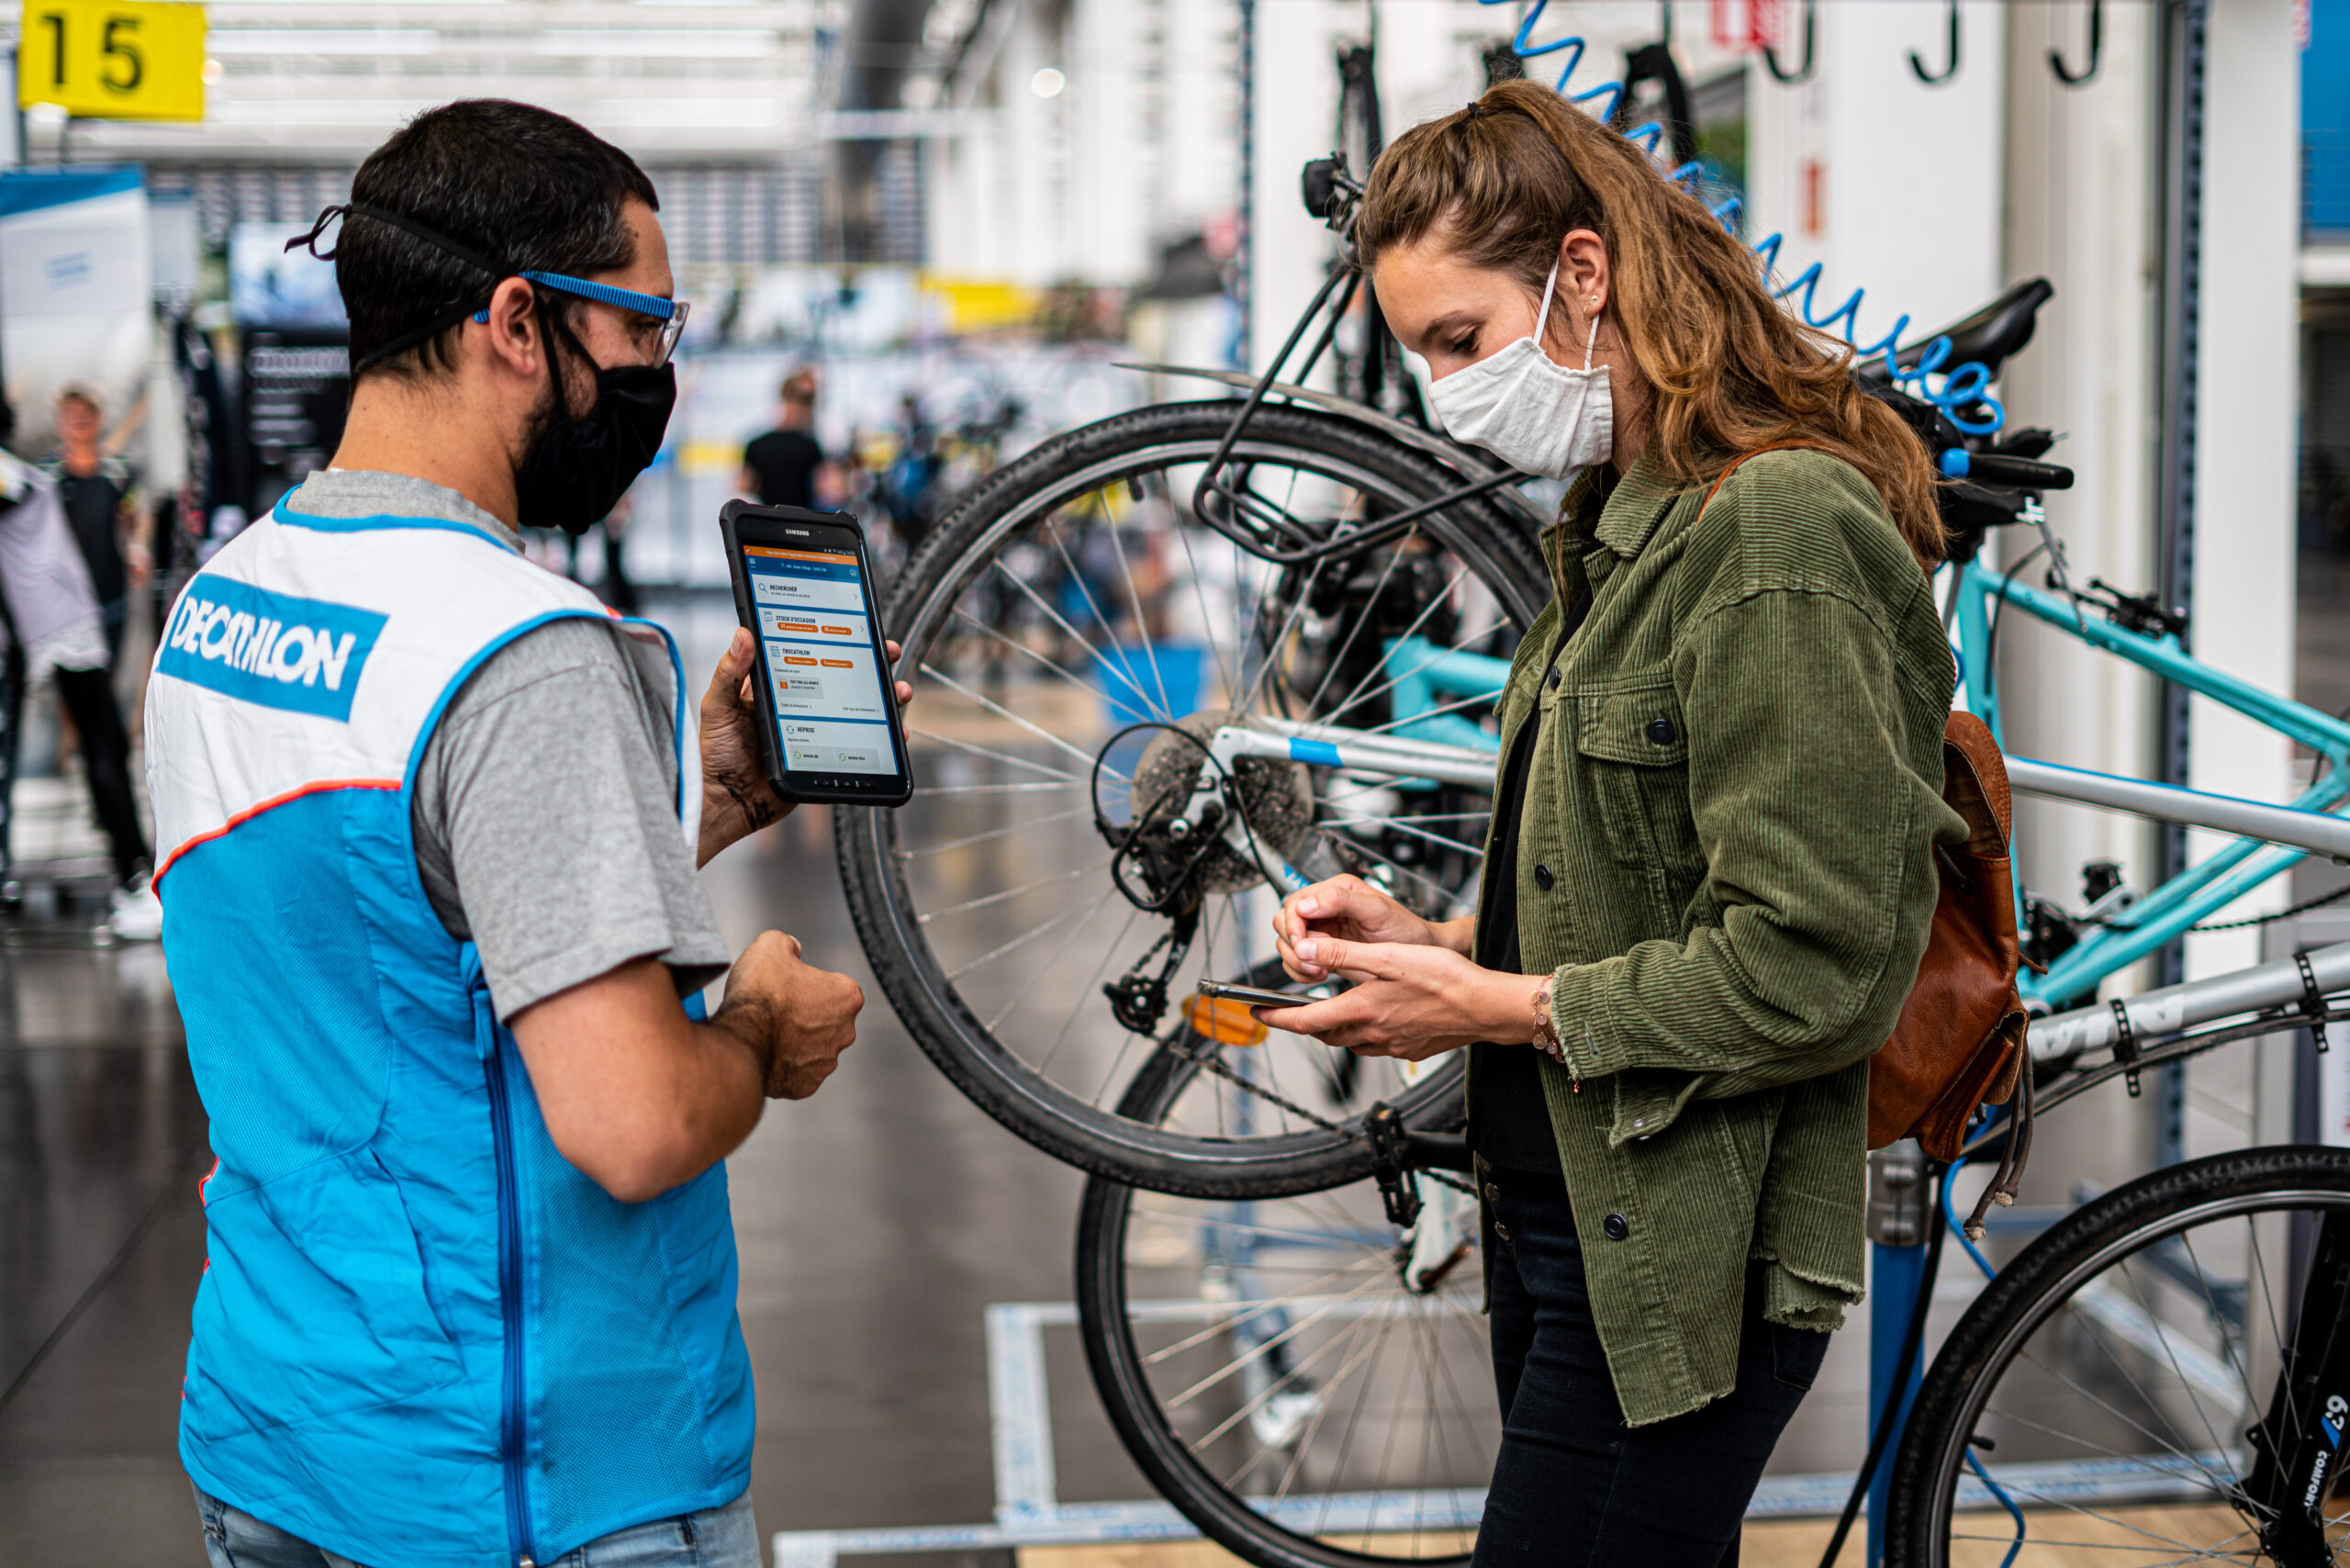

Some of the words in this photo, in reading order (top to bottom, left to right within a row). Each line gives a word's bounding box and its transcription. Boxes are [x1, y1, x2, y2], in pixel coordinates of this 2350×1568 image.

[41, 14, 143, 93] 15
[790, 616, 816, 624] D'OCCASION
[170, 596, 356, 691] DECATHLON
[782, 648, 811, 656] TROCATHLON
